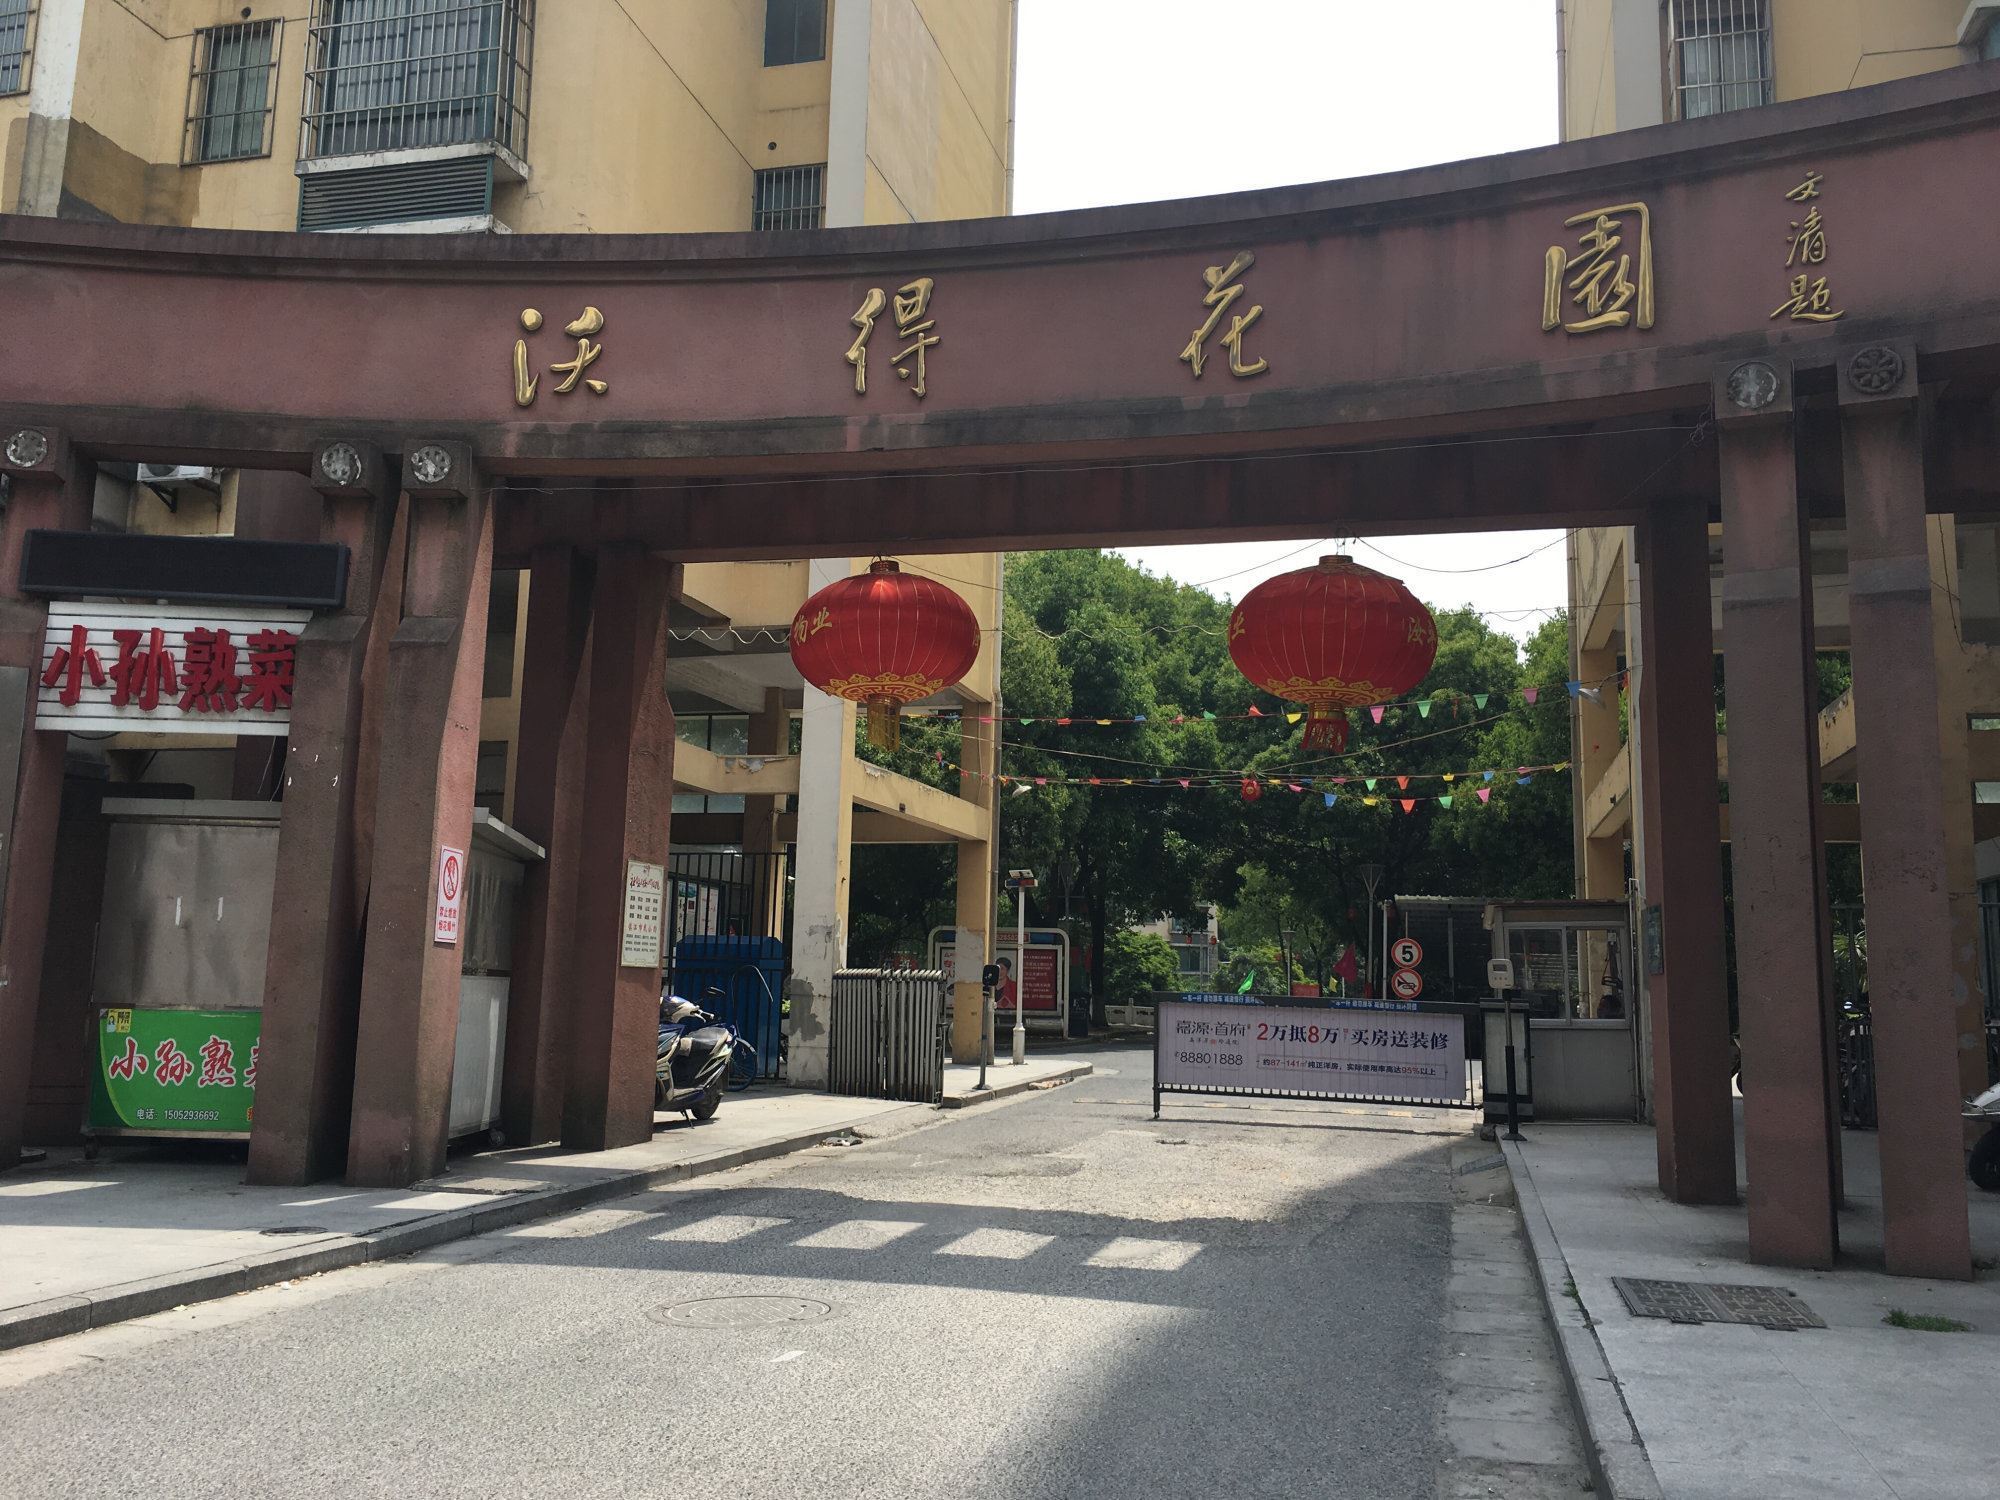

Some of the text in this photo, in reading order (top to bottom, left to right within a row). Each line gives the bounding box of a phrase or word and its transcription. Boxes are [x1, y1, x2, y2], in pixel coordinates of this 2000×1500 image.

[42, 624, 297, 713] 小孙熟菜
[1402, 945, 1414, 963] 5
[1256, 1022, 1340, 1044] 2万抵8万
[1350, 1028, 1450, 1050] 买房送装修
[1179, 1051, 1243, 1066] 88801888
